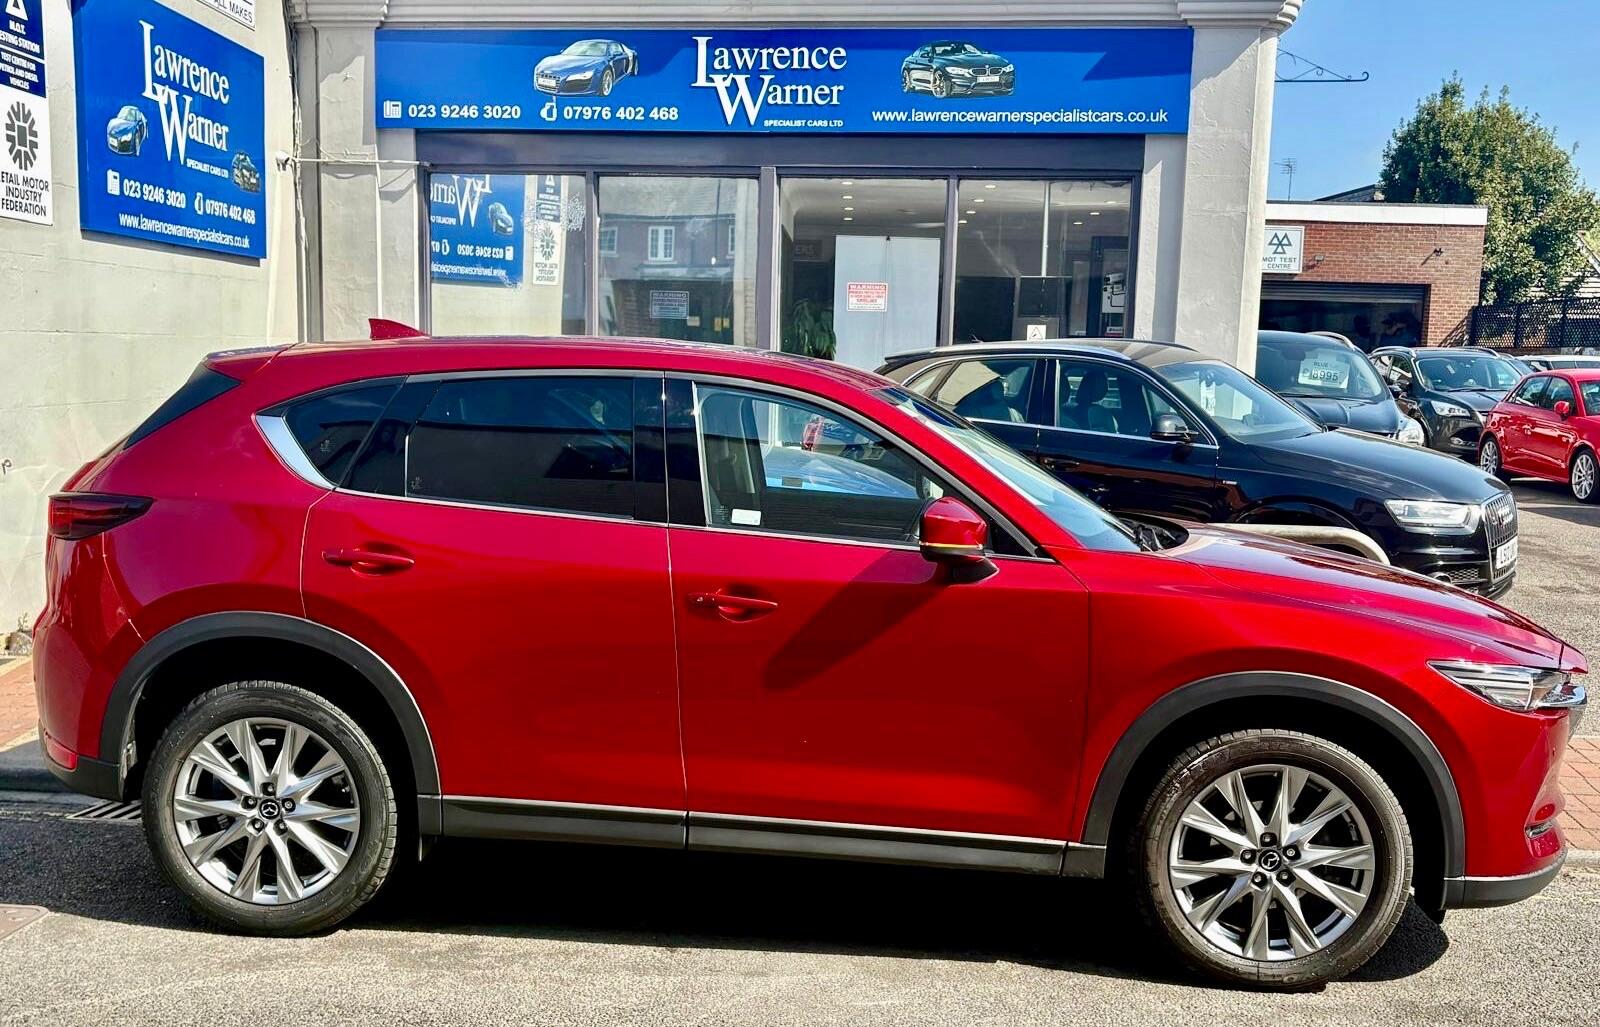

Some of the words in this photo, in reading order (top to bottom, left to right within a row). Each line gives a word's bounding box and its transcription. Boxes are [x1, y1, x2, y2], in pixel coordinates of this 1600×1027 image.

[229, 1, 253, 23] MAKES
[139, 20, 230, 104] Lawrence
[691, 36, 848, 87] Lawrence
[710, 74, 844, 125] Warner
[408, 105, 437, 119] 023
[441, 105, 480, 119] 9246
[483, 105, 521, 119] 3020
[563, 106, 612, 120] 07976
[616, 106, 645, 120] 402
[648, 106, 679, 121] 468
[871, 108, 1168, 126] www.lawrencewarnerspecialistcars.co.uk
[154, 83, 230, 165] Warner
[764, 119, 805, 128] SPECIALIST
[807, 119, 828, 128] CARS
[829, 119, 844, 128] LTD
[1, 171, 20, 186] ETAIL
[22, 175, 49, 192] MOTOR
[6, 185, 42, 203] INDUSTRY
[123, 179, 141, 199] 023
[142, 184, 164, 204] 9246
[166, 189, 186, 209] 3020
[2, 198, 47, 217] FEDERATION
[206, 199, 228, 218] 07976
[229, 204, 242, 221] 402
[243, 208, 256, 225] 468
